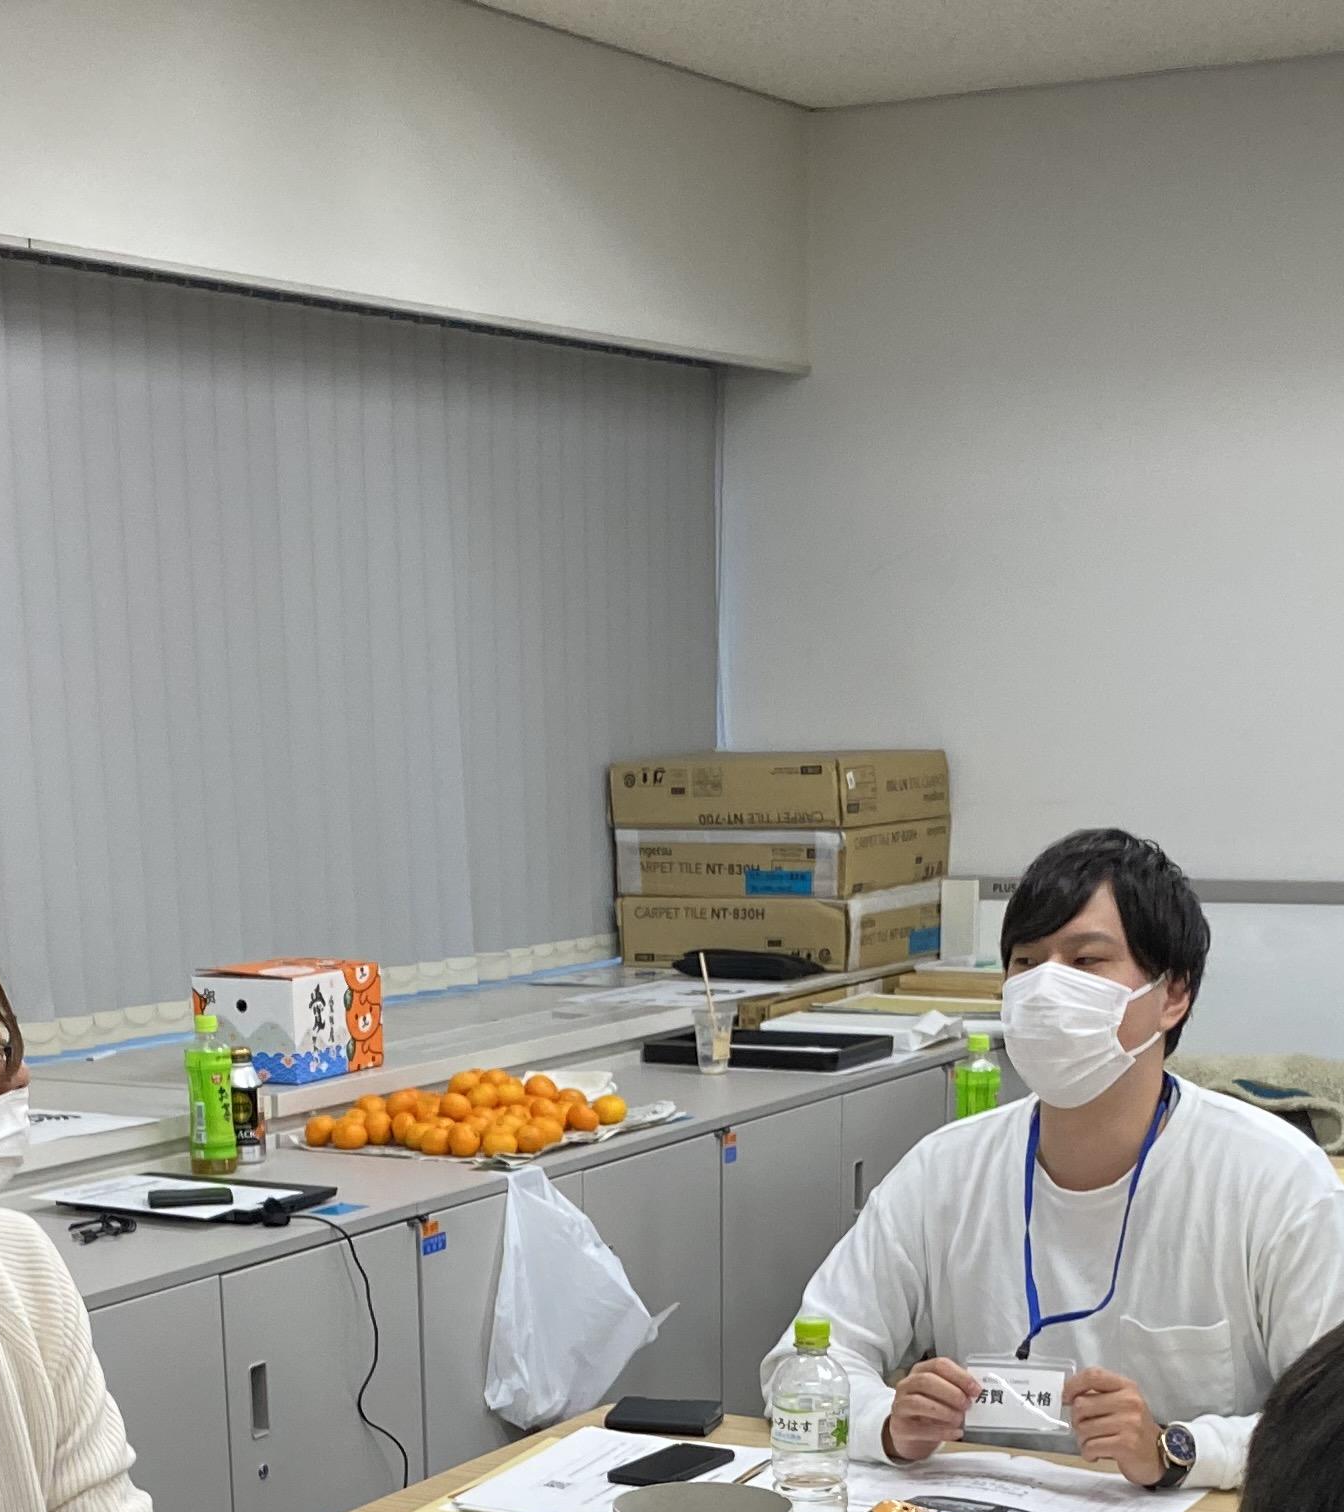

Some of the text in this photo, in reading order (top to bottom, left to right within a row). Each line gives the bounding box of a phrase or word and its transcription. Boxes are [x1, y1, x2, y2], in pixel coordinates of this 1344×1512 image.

[639, 862, 674, 874] ARPET
[679, 862, 703, 875] TILE
[634, 907, 765, 921] CARPET TILE NT-830H
